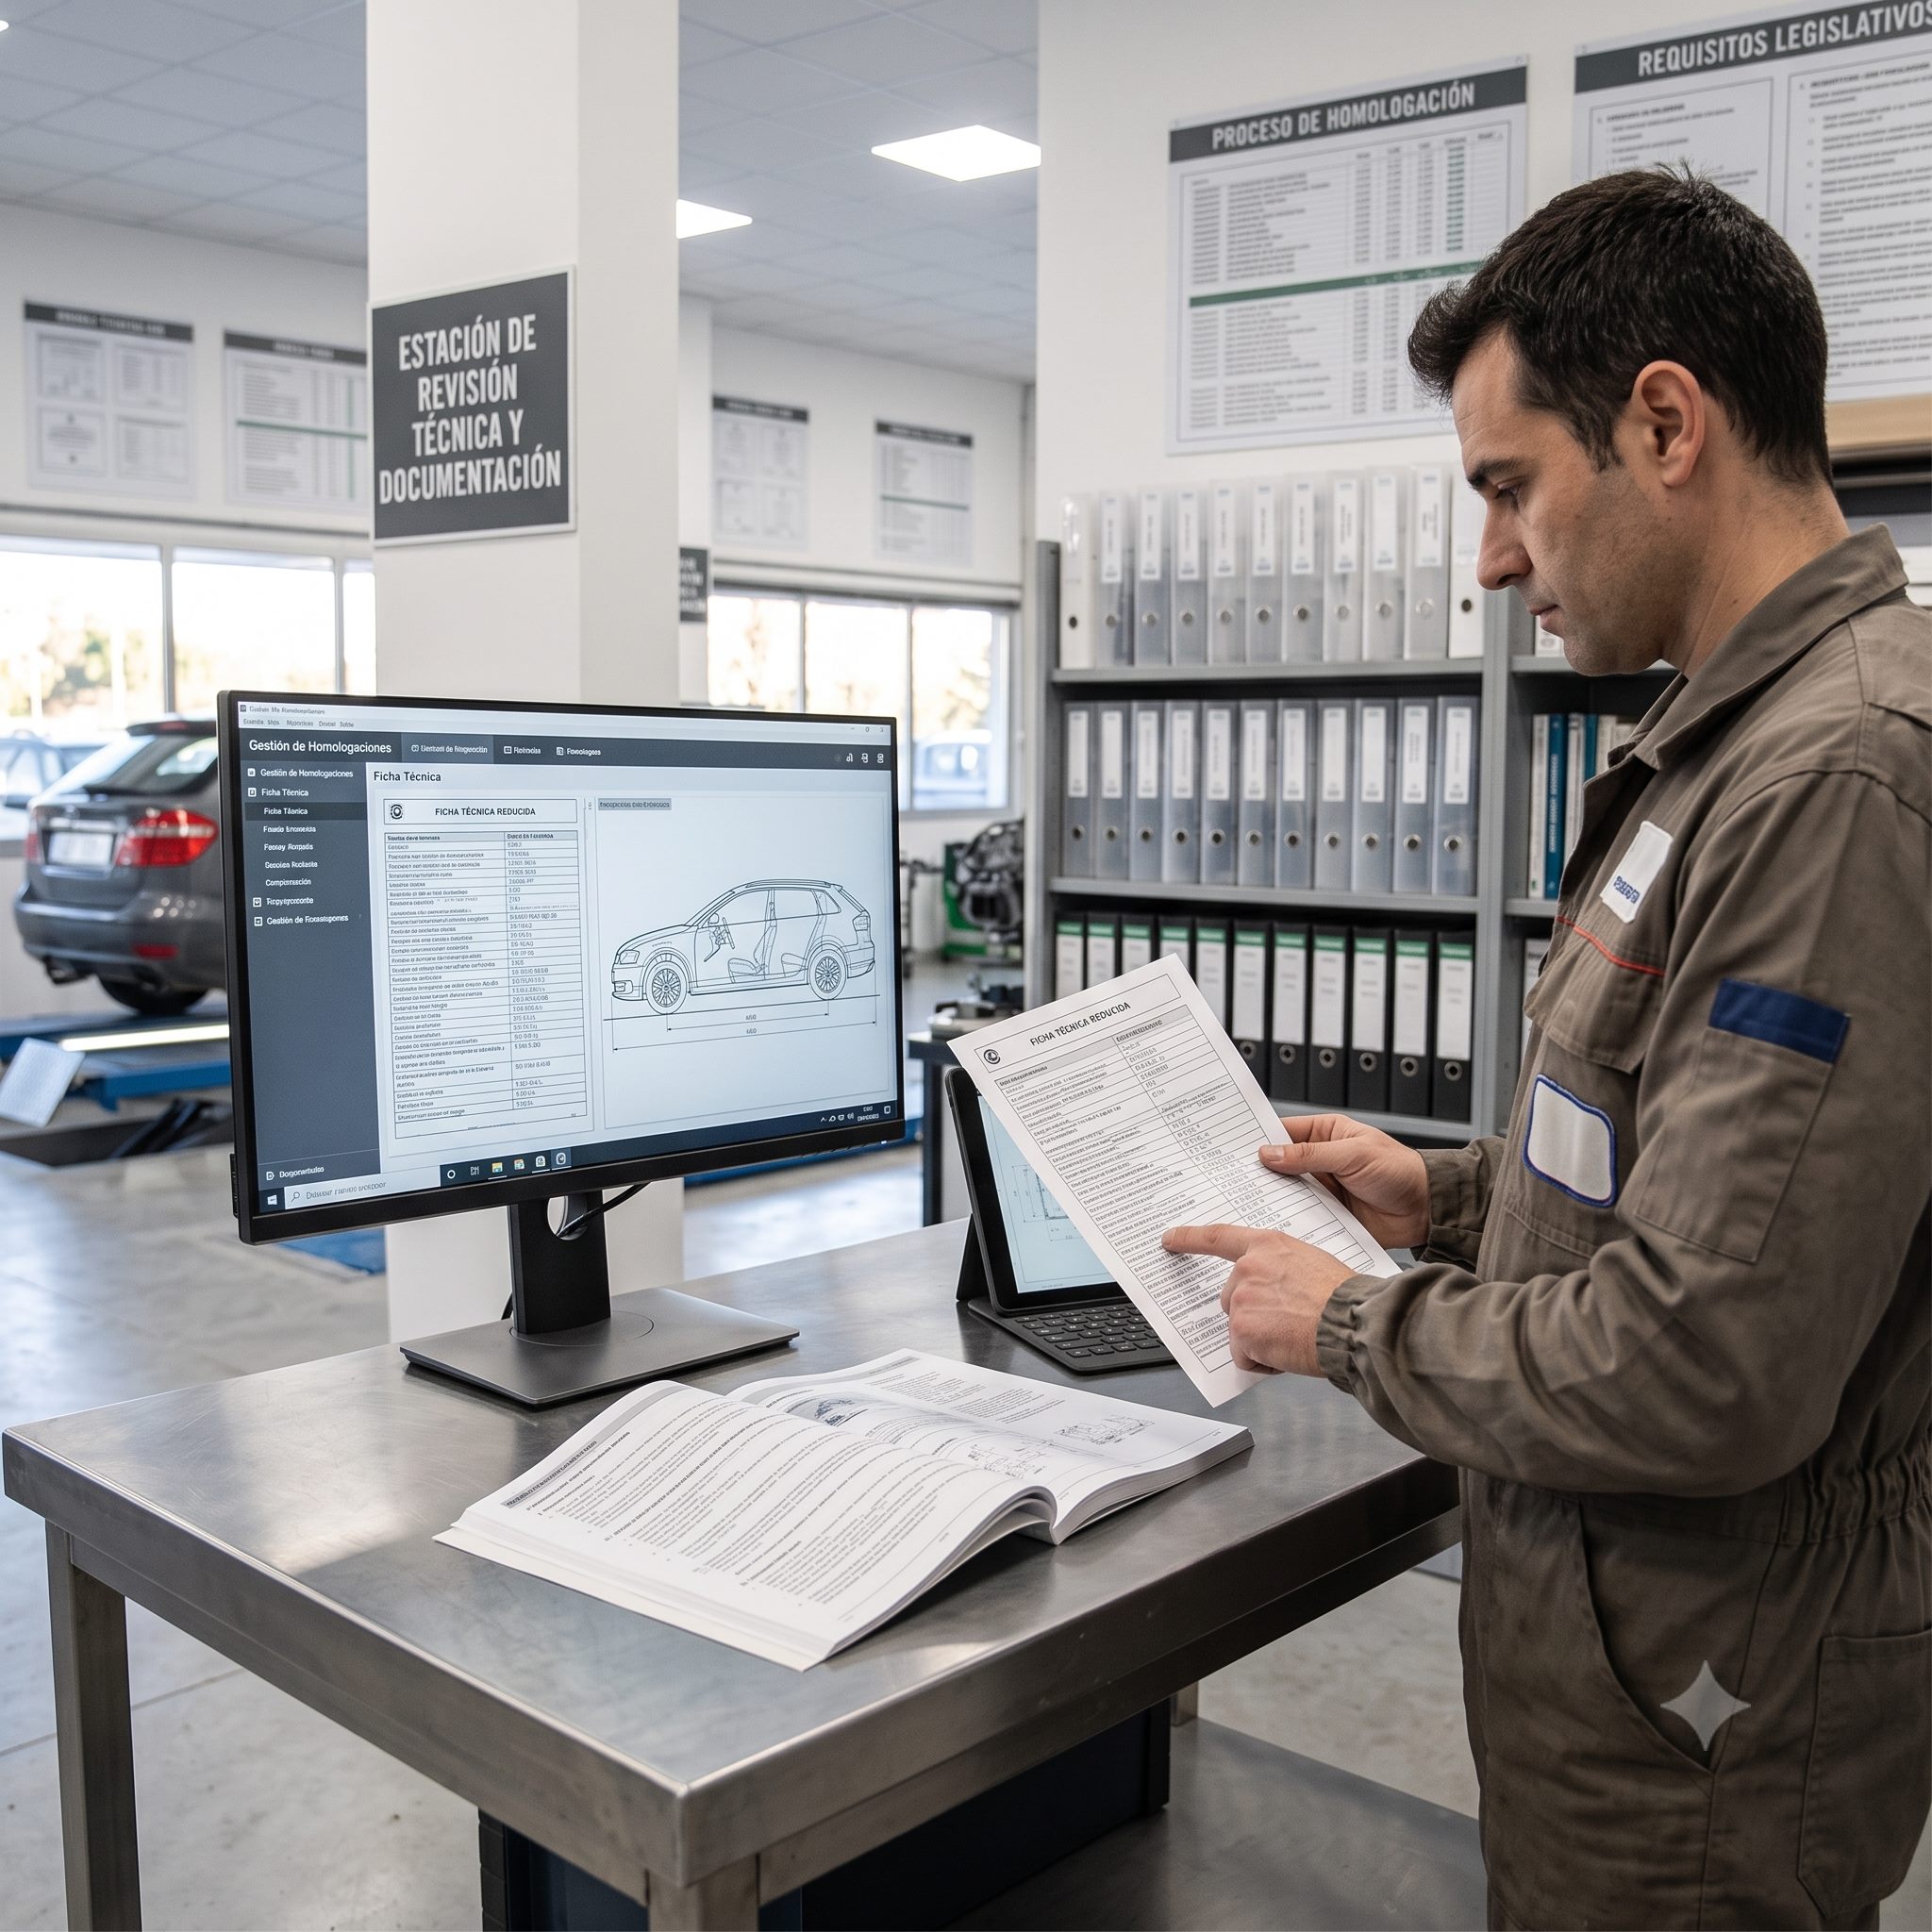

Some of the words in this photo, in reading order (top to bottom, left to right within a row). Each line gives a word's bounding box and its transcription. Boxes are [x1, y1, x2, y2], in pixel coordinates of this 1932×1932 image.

[1638, 29, 1768, 77] REQUISITOS
[1212, 115, 1292, 150] PROCESO
[1298, 110, 1322, 136] DE
[1326, 80, 1475, 130] HOMOLOGACIÓN
[399, 314, 501, 371] ESTACIÓN
[508, 313, 537, 354] DE
[418, 358, 518, 412] REVISIÓN
[411, 411, 503, 458] TÉCNICA
[508, 408, 524, 445] Y
[379, 443, 561, 505] DOCUMENTACIÓN
[249, 739, 290, 752] Gestión
[292, 741, 306, 752] de
[308, 741, 391, 755] Homologaciones
[289, 769, 297, 777] de
[374, 771, 401, 781] Ficha
[435, 808, 459, 816] FICHA
[461, 806, 495, 816] TÉCNICA
[497, 808, 536, 816] REDUCIDA
[1029, 1032, 1056, 1046] FICHA
[1089, 1002, 1131, 1023] REDUCIDA
